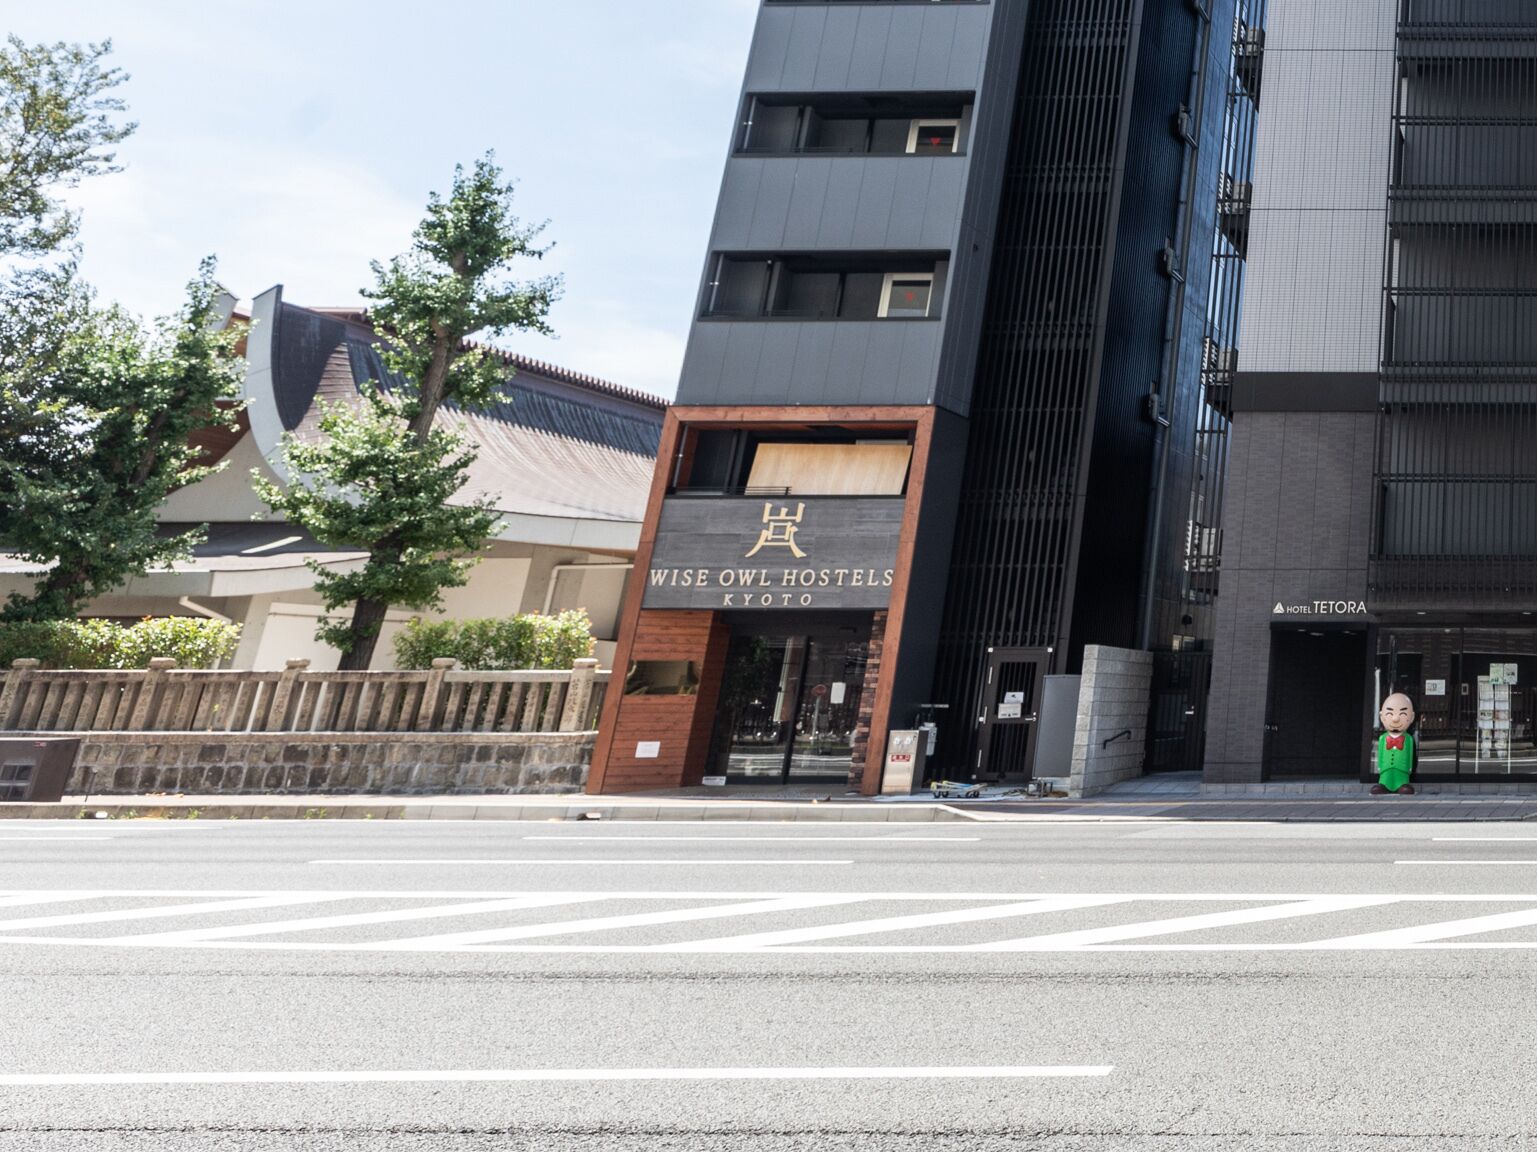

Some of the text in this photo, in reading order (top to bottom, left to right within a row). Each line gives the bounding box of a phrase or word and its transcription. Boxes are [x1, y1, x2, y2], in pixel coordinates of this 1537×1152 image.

[650, 568, 895, 587] WISE OWL HOSTELS
[723, 593, 812, 606] KYOTO
[1286, 600, 1367, 614] HOTEL TETORA
